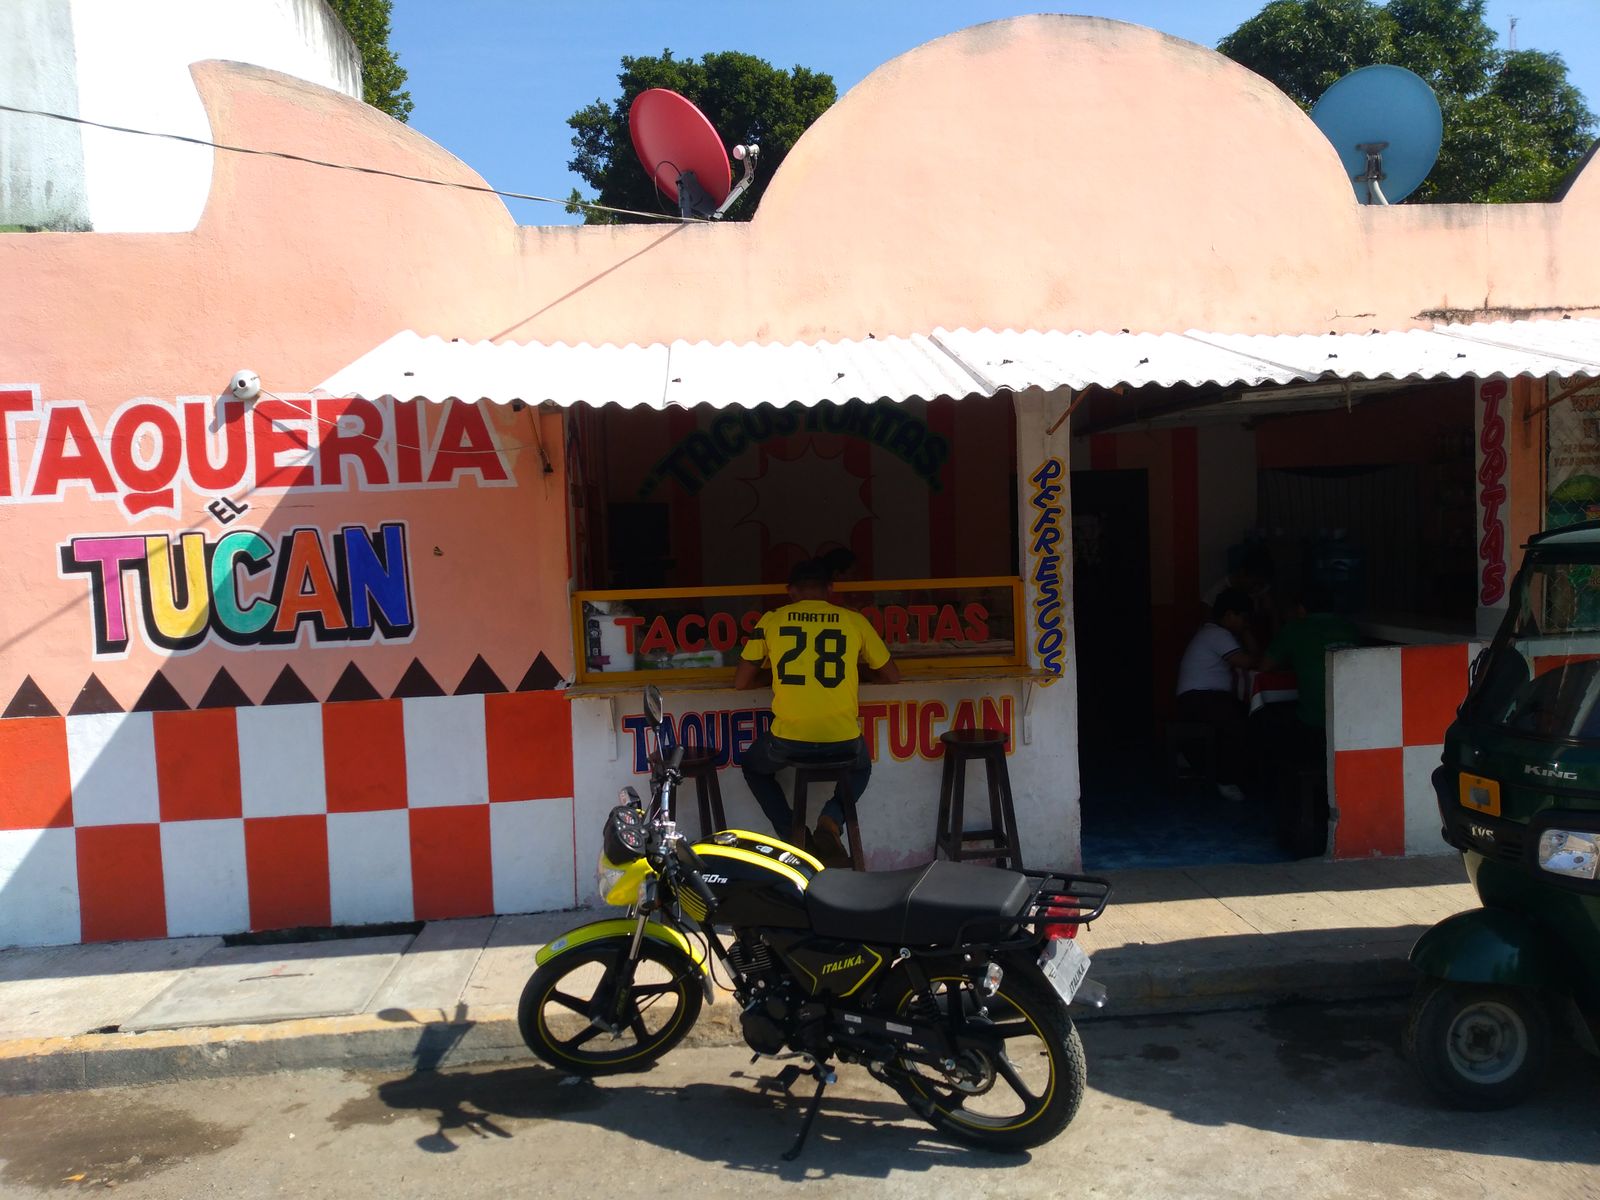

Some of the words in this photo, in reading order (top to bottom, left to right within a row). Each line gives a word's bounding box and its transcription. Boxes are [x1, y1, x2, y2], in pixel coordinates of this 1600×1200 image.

[0, 388, 509, 515] TAQUERIA
[208, 497, 248, 524] EL
[1479, 380, 1507, 605] TORTAS
[62, 522, 412, 654] TUCAN
[1031, 458, 1064, 686] REFRESCOS
[788, 612, 839, 622] MARTIN
[860, 603, 989, 644] ORTAS
[777, 626, 846, 688] 28
[858, 695, 1016, 763] TUCAN
[1524, 764, 1578, 780] KING
[822, 955, 862, 975] ITALIKA
